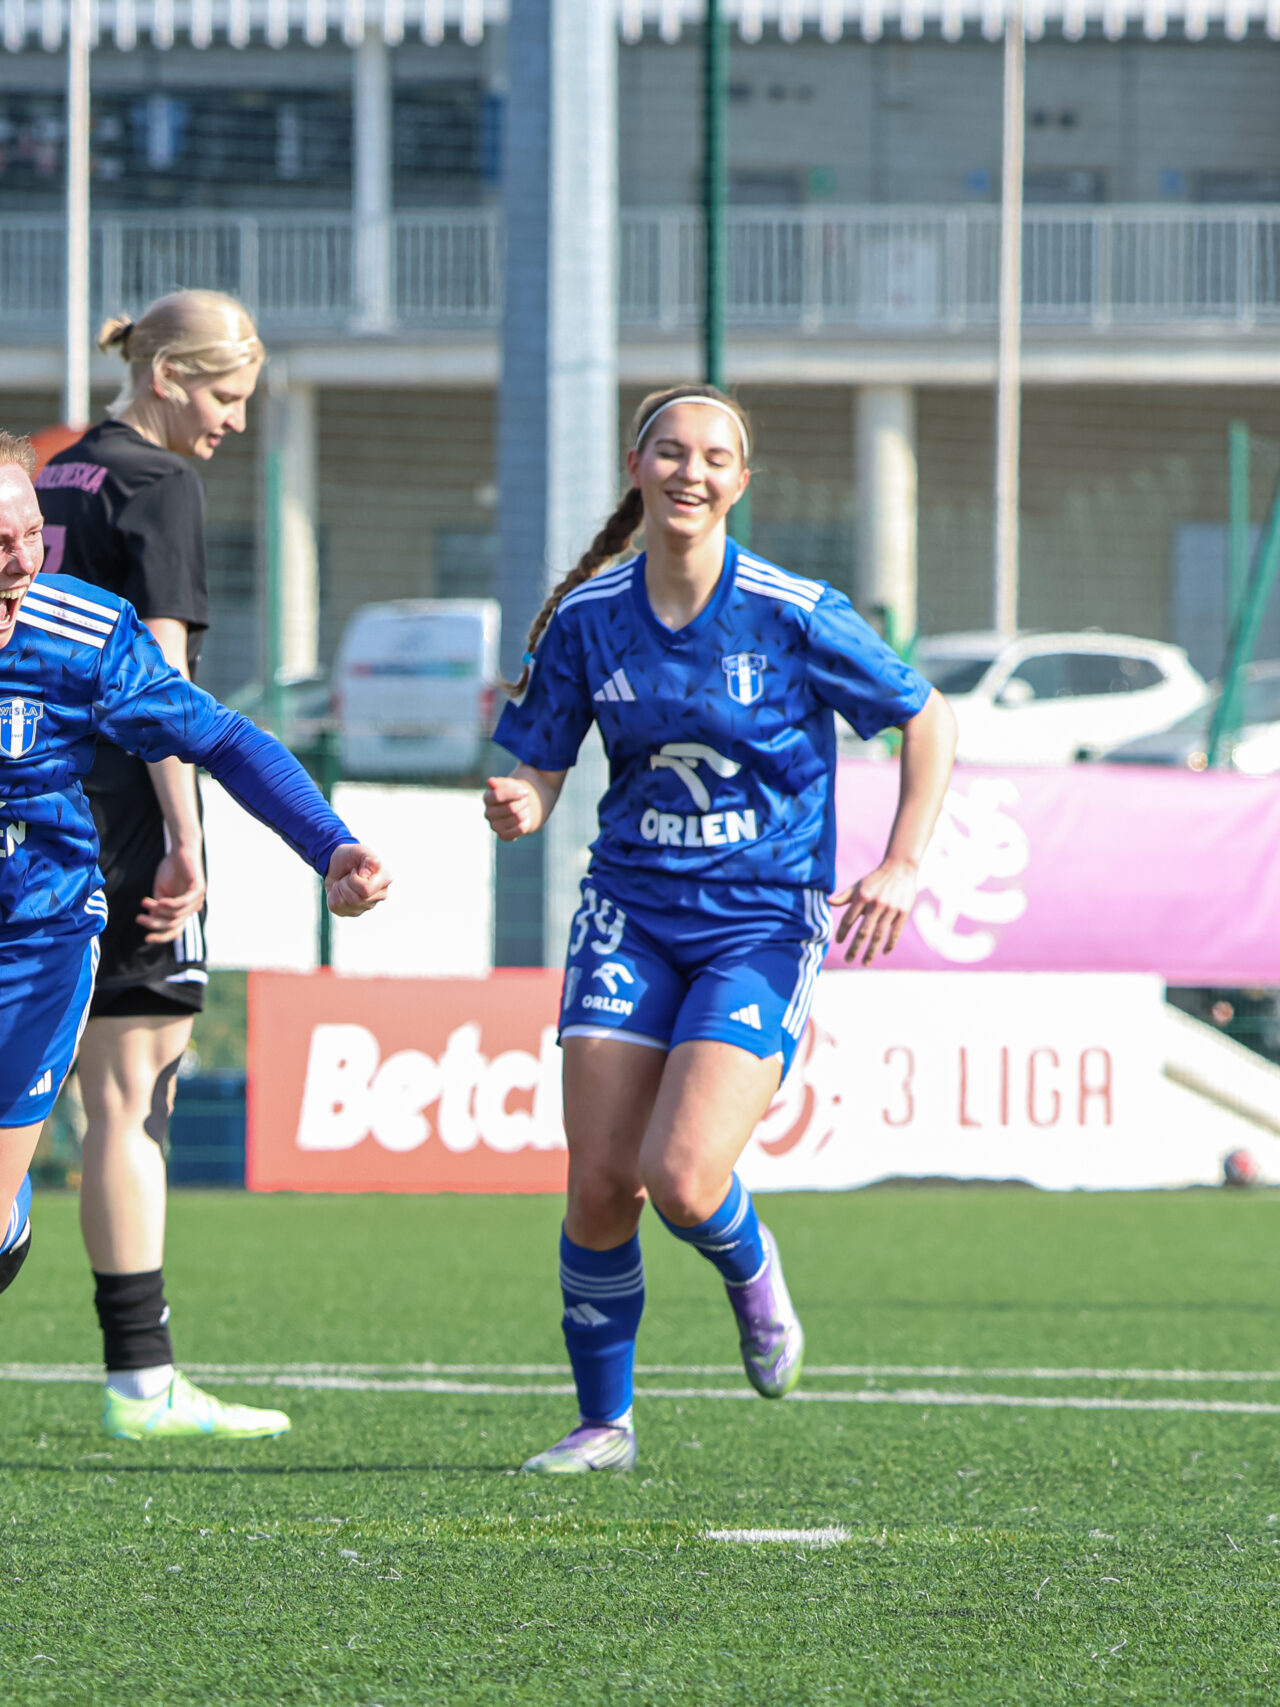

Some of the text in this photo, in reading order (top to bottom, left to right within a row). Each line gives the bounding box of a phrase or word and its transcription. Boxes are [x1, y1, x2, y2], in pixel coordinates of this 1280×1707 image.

[640, 808, 758, 848] ORLEN
[581, 994, 634, 1017] ORLEN
[880, 1045, 1114, 1128] 3 LIGA
